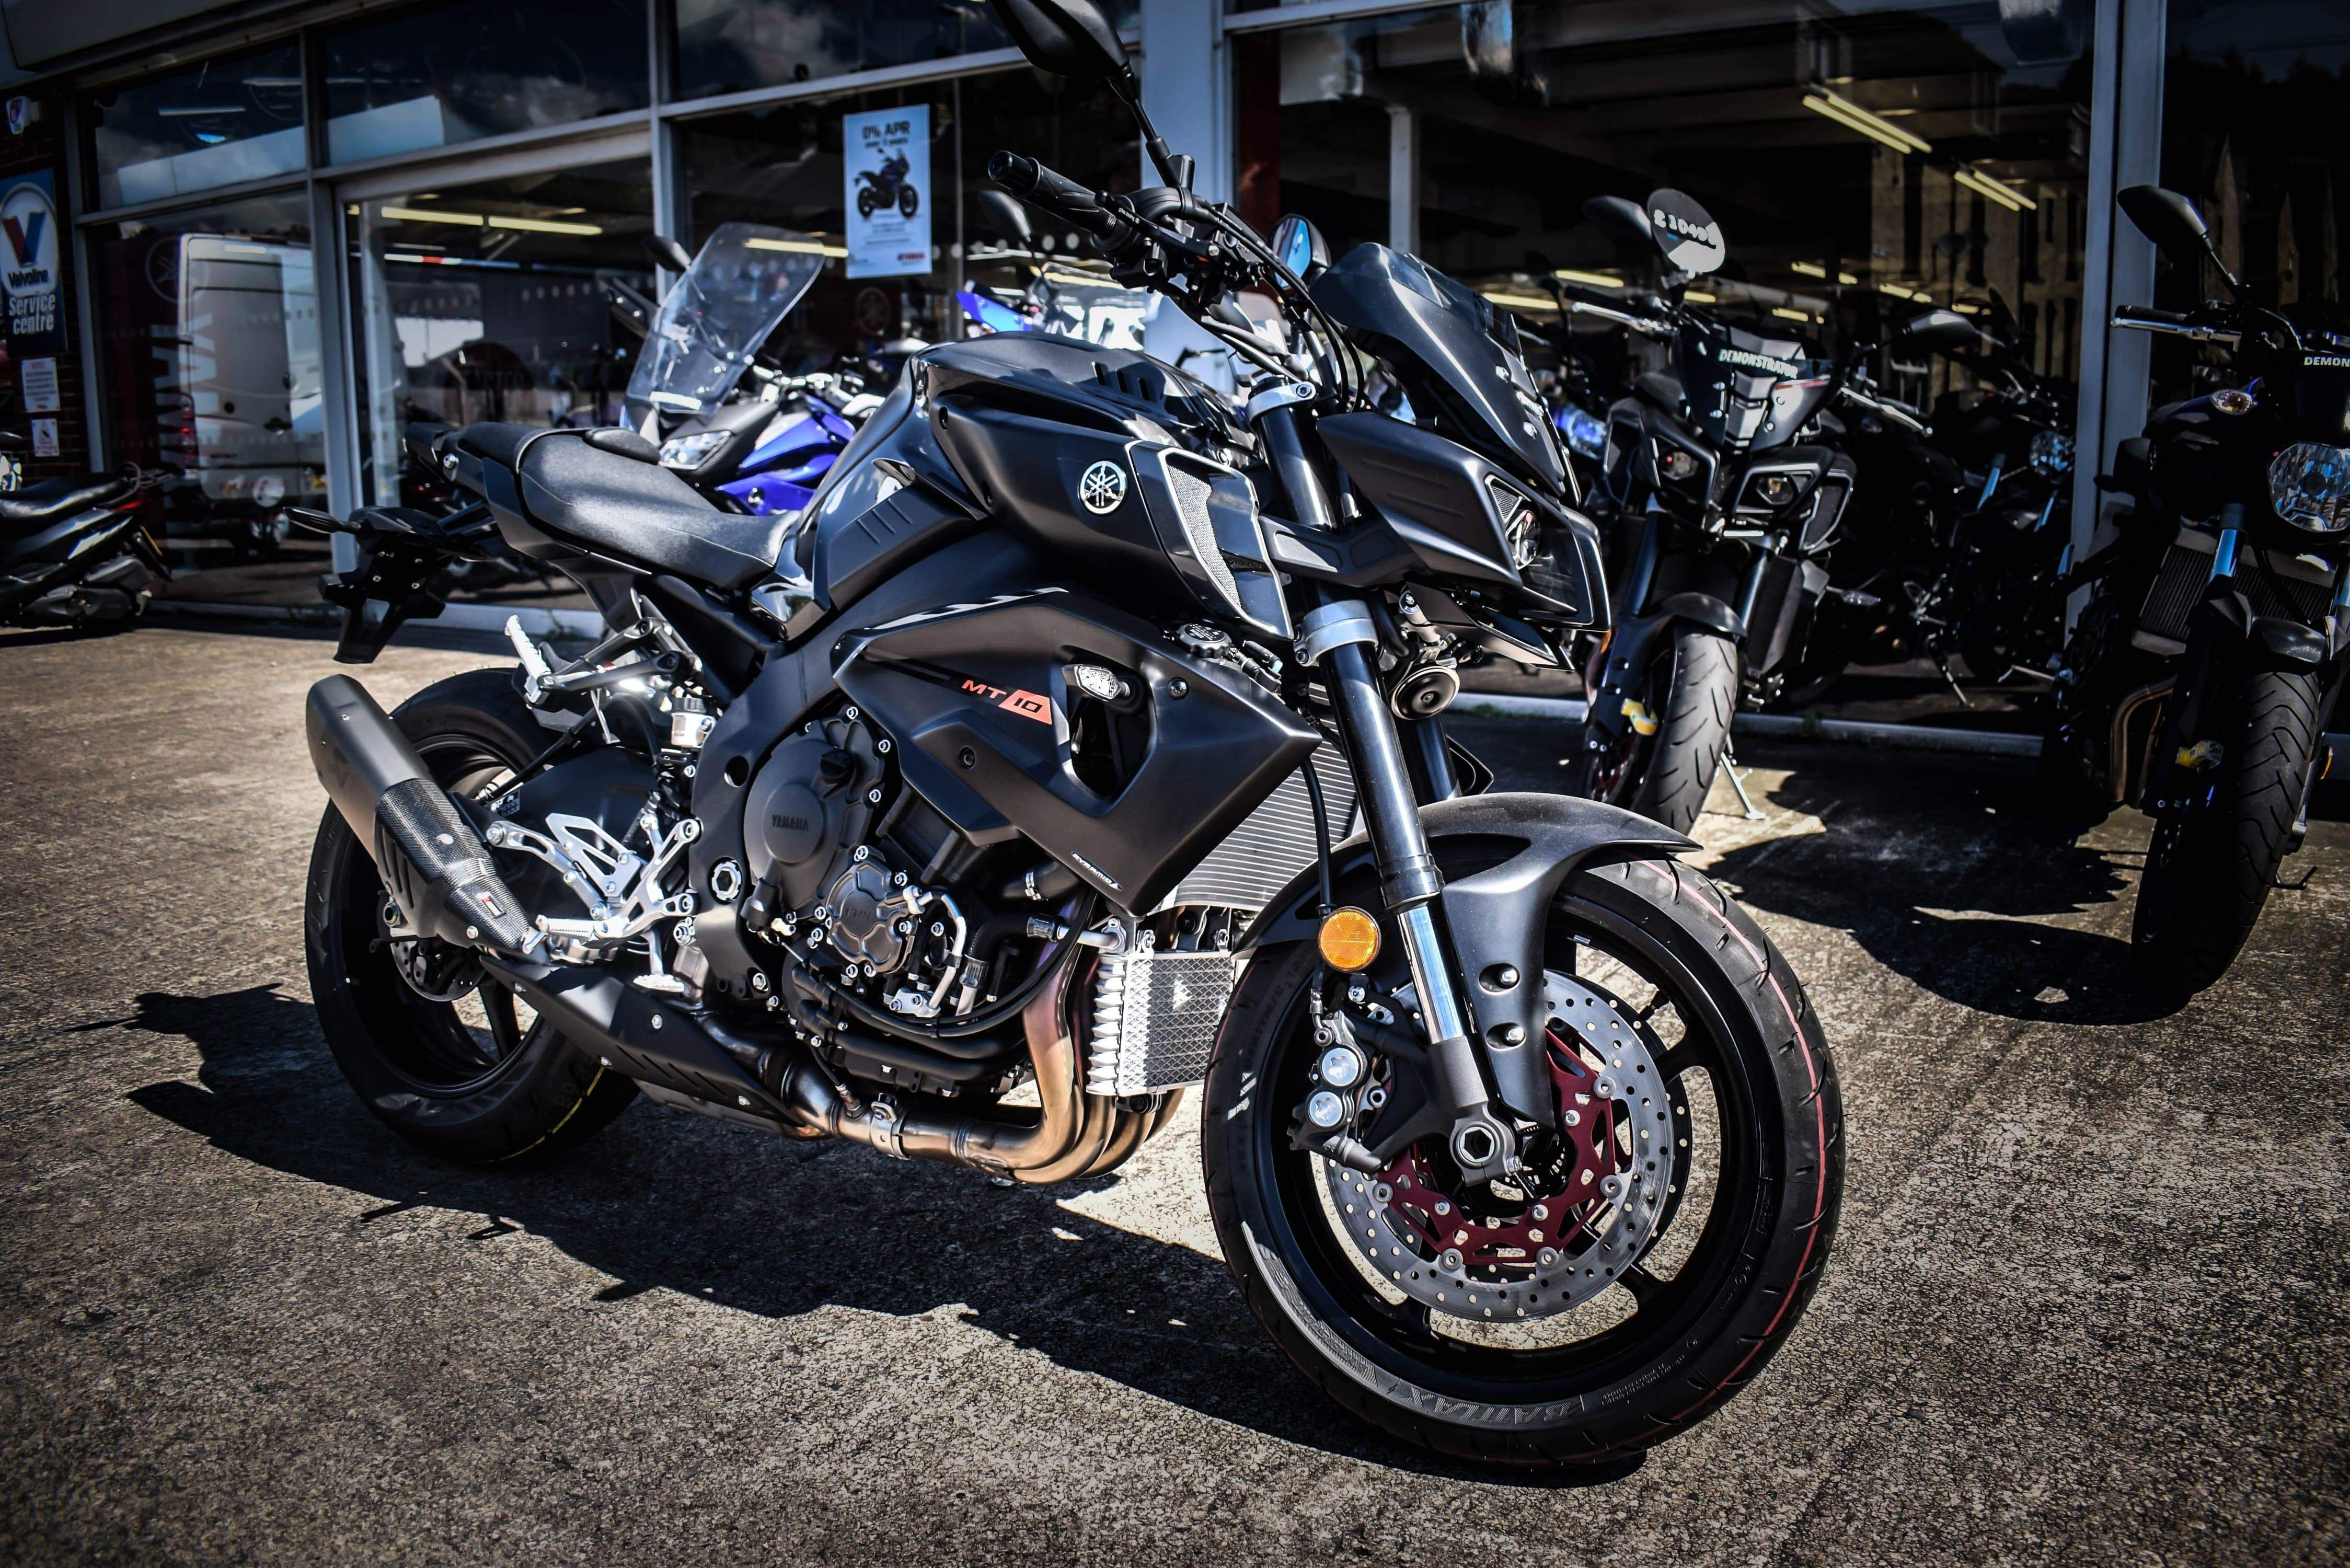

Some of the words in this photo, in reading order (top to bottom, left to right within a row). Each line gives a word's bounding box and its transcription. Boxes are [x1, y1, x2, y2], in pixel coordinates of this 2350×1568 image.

[885, 121, 910, 135] APR
[8, 269, 49, 287] Valvoline
[9, 293, 56, 317] Service
[13, 314, 54, 335] centre
[1719, 349, 1798, 379] DEMONSTRATOR
[2304, 356, 2350, 367] DEMON
[962, 679, 1007, 699] MT
[772, 814, 809, 833] YAMAHA
[1401, 1386, 1572, 1424] BATTLAX
